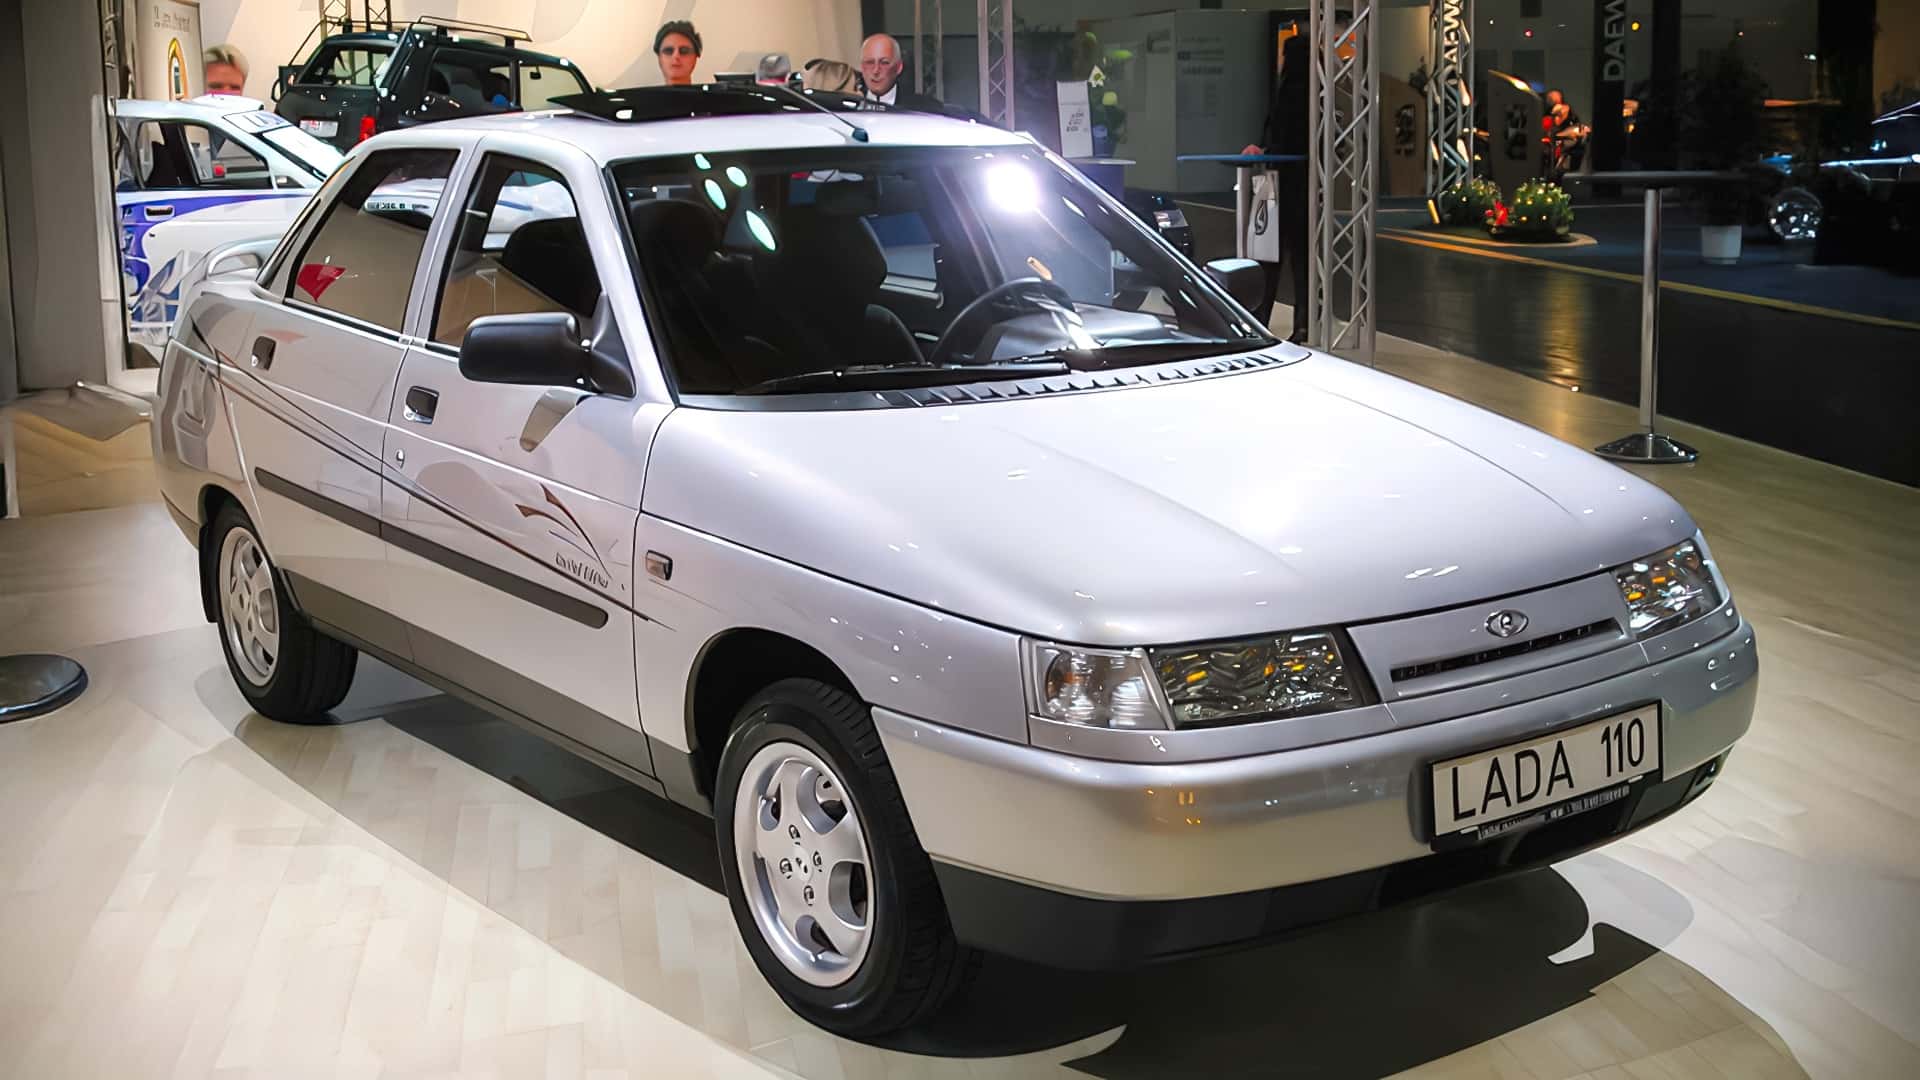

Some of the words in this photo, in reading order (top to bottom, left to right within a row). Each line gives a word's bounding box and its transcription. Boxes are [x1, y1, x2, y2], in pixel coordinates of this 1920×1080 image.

[1443, 0, 1463, 85] DAEW
[1452, 740, 1575, 821] LADA
[1601, 718, 1644, 777] 110
